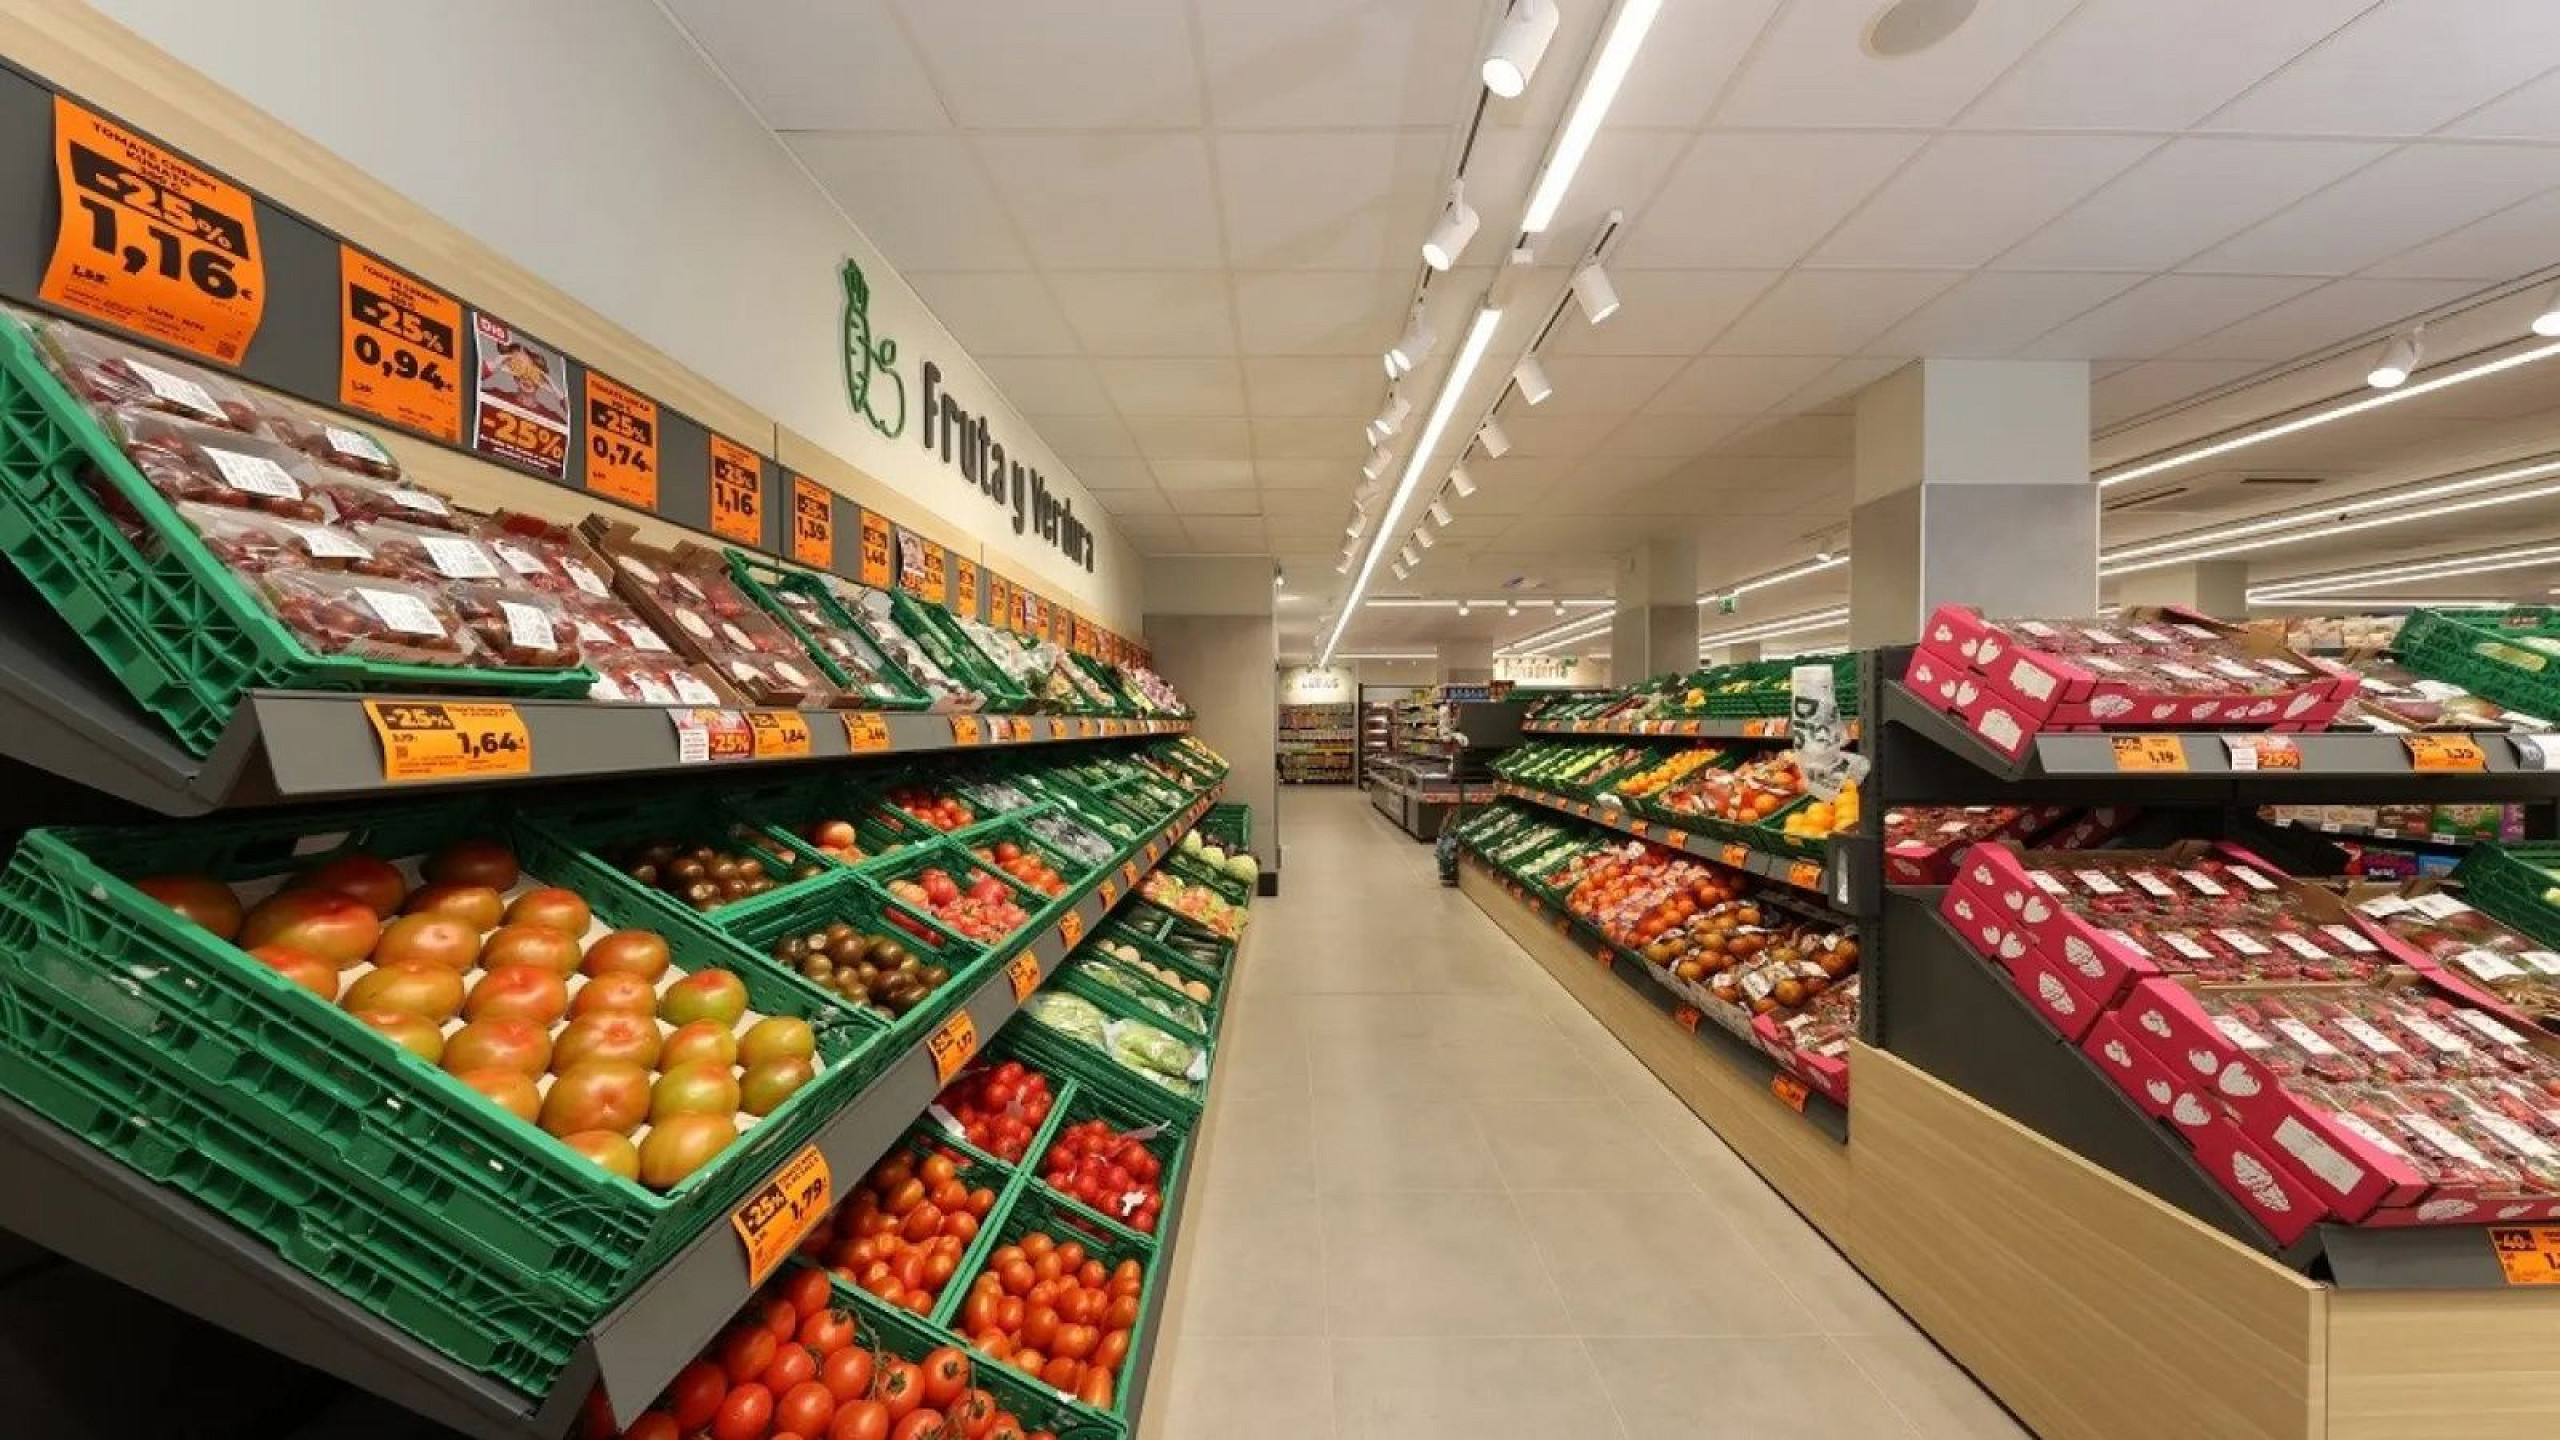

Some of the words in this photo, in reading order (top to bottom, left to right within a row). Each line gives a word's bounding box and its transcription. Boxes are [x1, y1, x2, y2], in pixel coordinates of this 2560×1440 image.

[92, 121, 157, 161] TOMATE
[95, 171, 233, 251] -25%
[362, 301, 444, 352] -25%
[482, 409, 563, 460] -25%
[597, 409, 650, 443] -25%
[925, 361, 1005, 505] Fruta
[1011, 460, 1024, 535] y
[1029, 467, 1094, 573] Verdura
[386, 708, 449, 728] -25%
[748, 1191, 786, 1226] -25%
